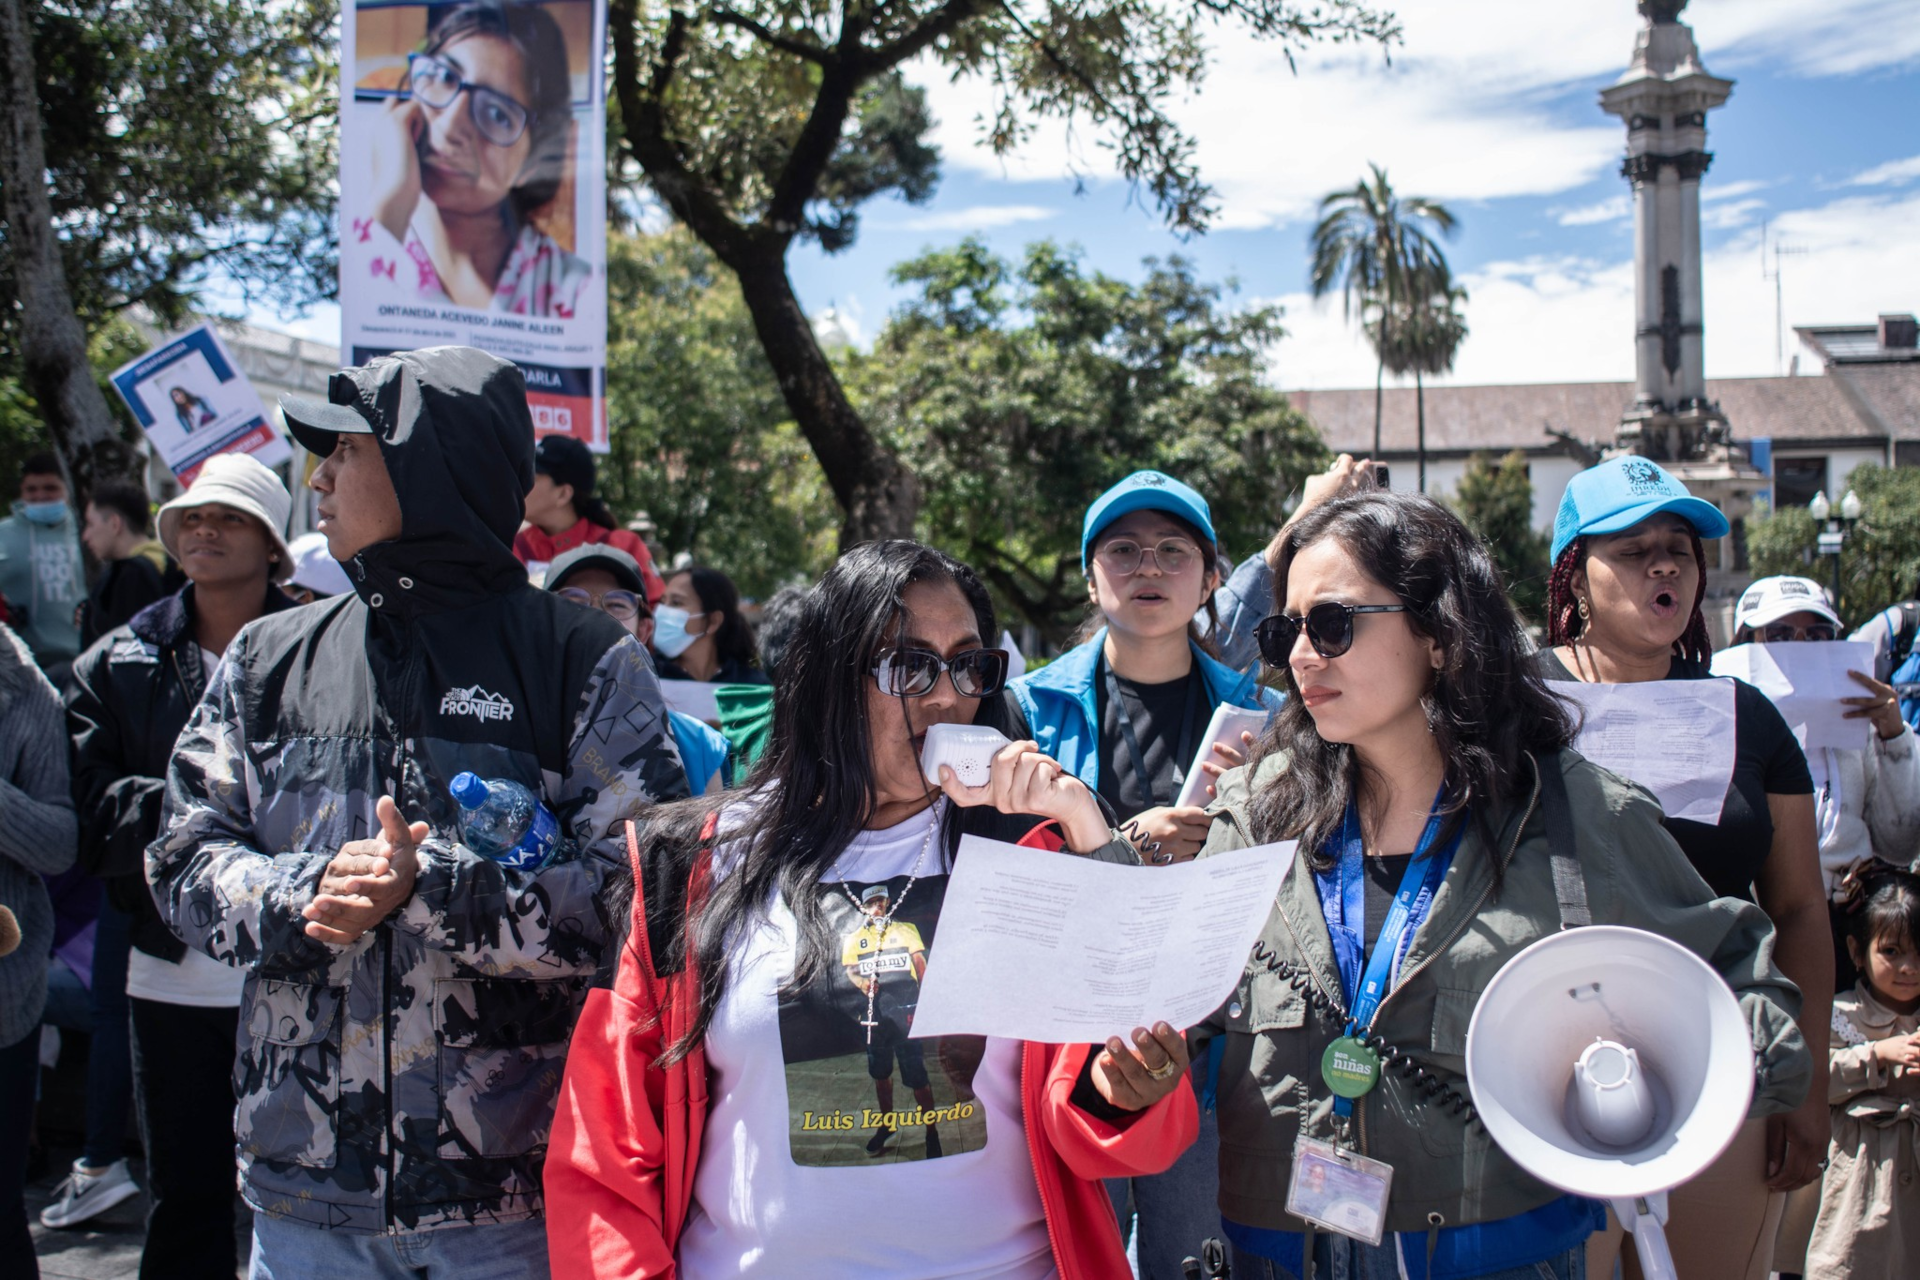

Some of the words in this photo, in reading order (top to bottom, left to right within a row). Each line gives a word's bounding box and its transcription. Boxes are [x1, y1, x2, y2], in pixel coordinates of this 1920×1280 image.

[379, 304, 437, 319] ONTANEDA
[441, 310, 489, 326] ACEVEDO
[491, 318, 525, 331] JANINE
[529, 323, 564, 336] AILEEN
[38, 563, 71, 581] DO
[440, 697, 515, 724] FRONTIER
[582, 747, 627, 796] BRAND
[860, 938, 868, 949] 8
[1332, 1058, 1372, 1075] niñas
[802, 1109, 854, 1131] Luis
[861, 1101, 974, 1132] Izquierdo
